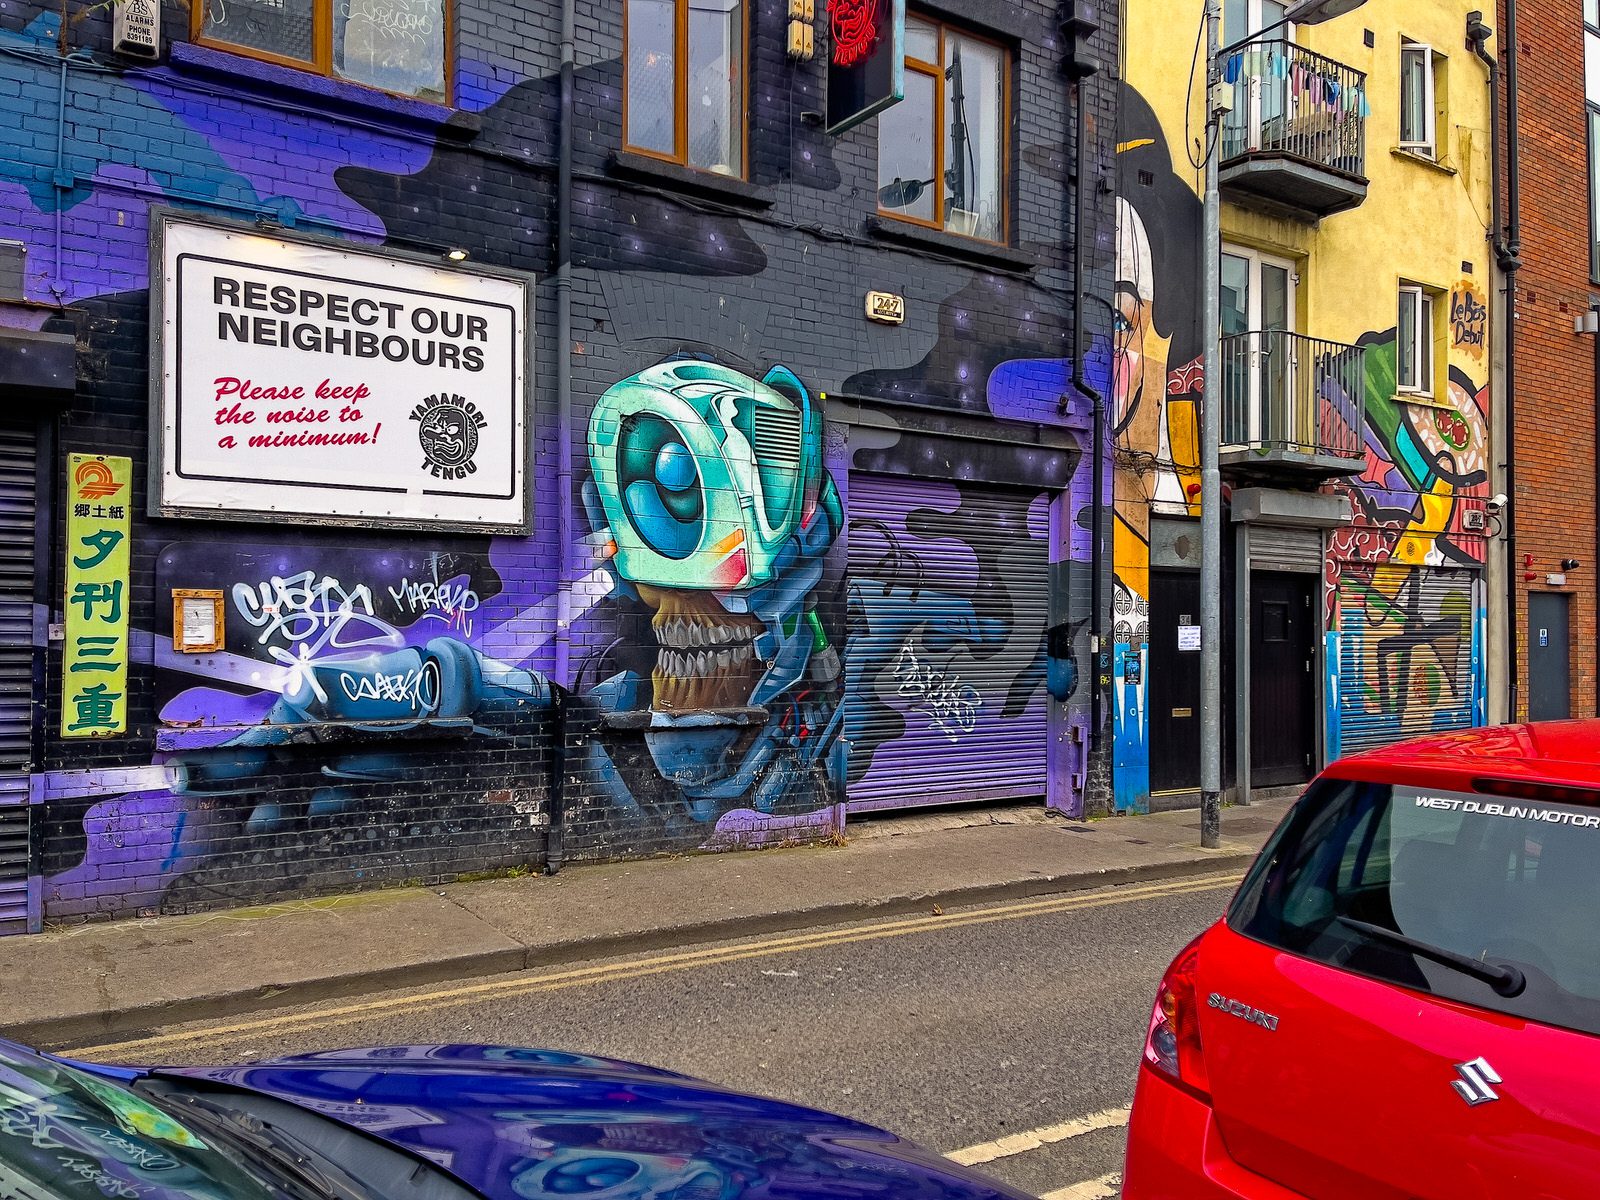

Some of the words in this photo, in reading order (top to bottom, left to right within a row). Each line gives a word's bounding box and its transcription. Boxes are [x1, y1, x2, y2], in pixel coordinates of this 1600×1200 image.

[126, 14, 154, 26] ALARMS
[129, 25, 151, 36] PHONE
[833, 22, 876, 65] TENGU
[213, 276, 403, 329] RESPECT
[411, 307, 488, 342] OUR
[218, 312, 485, 372] NEIGHBOURS
[213, 376, 305, 401] Please
[314, 378, 371, 404] keep
[214, 402, 256, 425] the
[267, 405, 330, 423] noise
[338, 405, 363, 423] to
[409, 392, 488, 429] YAMAMORI
[218, 434, 237, 449] a
[248, 422, 382, 448] minimum!
[421, 456, 477, 480] TENGU
[74, 503, 125, 520] 郷土紙
[68, 528, 125, 732] 夕刊三重
[1415, 795, 1464, 811] WEST
[1463, 801, 1527, 819] DUBLIN
[1207, 992, 1279, 1031] SUZUKI
